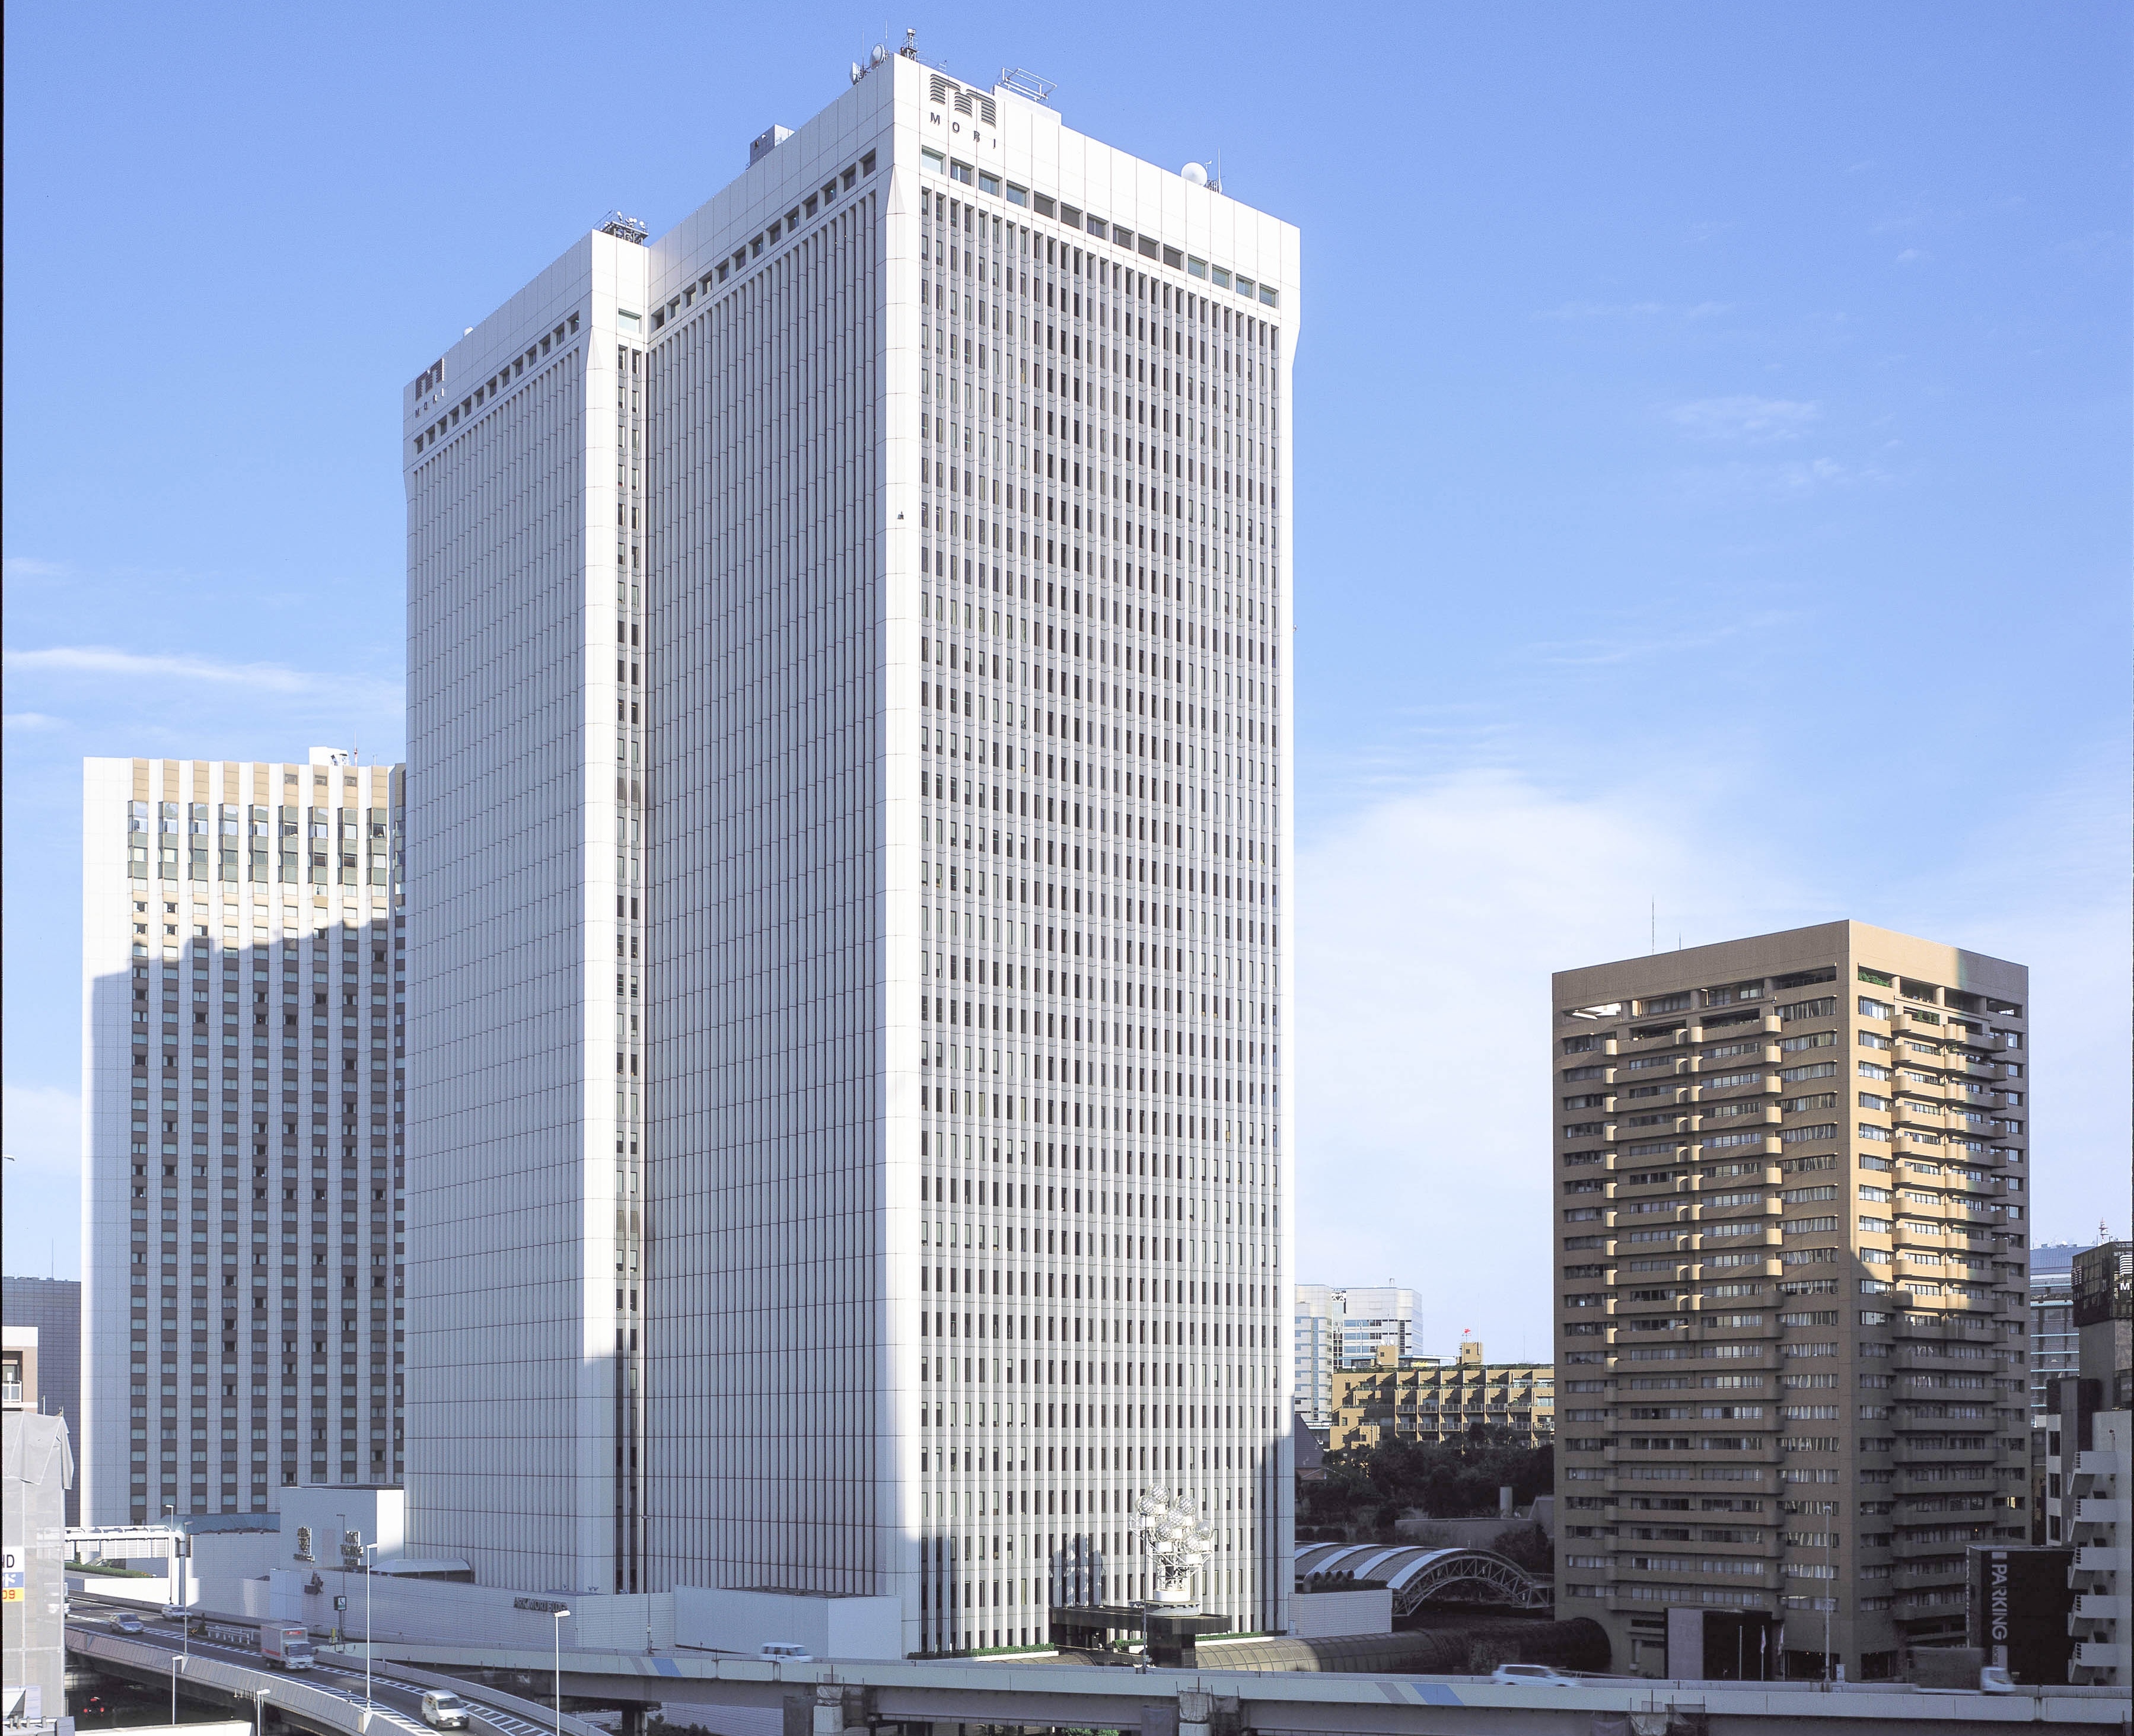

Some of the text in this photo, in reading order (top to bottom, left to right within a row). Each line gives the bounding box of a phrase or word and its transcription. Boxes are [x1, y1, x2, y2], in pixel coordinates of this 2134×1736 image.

[929, 112, 996, 149] MORI
[415, 387, 444, 418] MORI
[1992, 1563, 2008, 1641] PARKING
